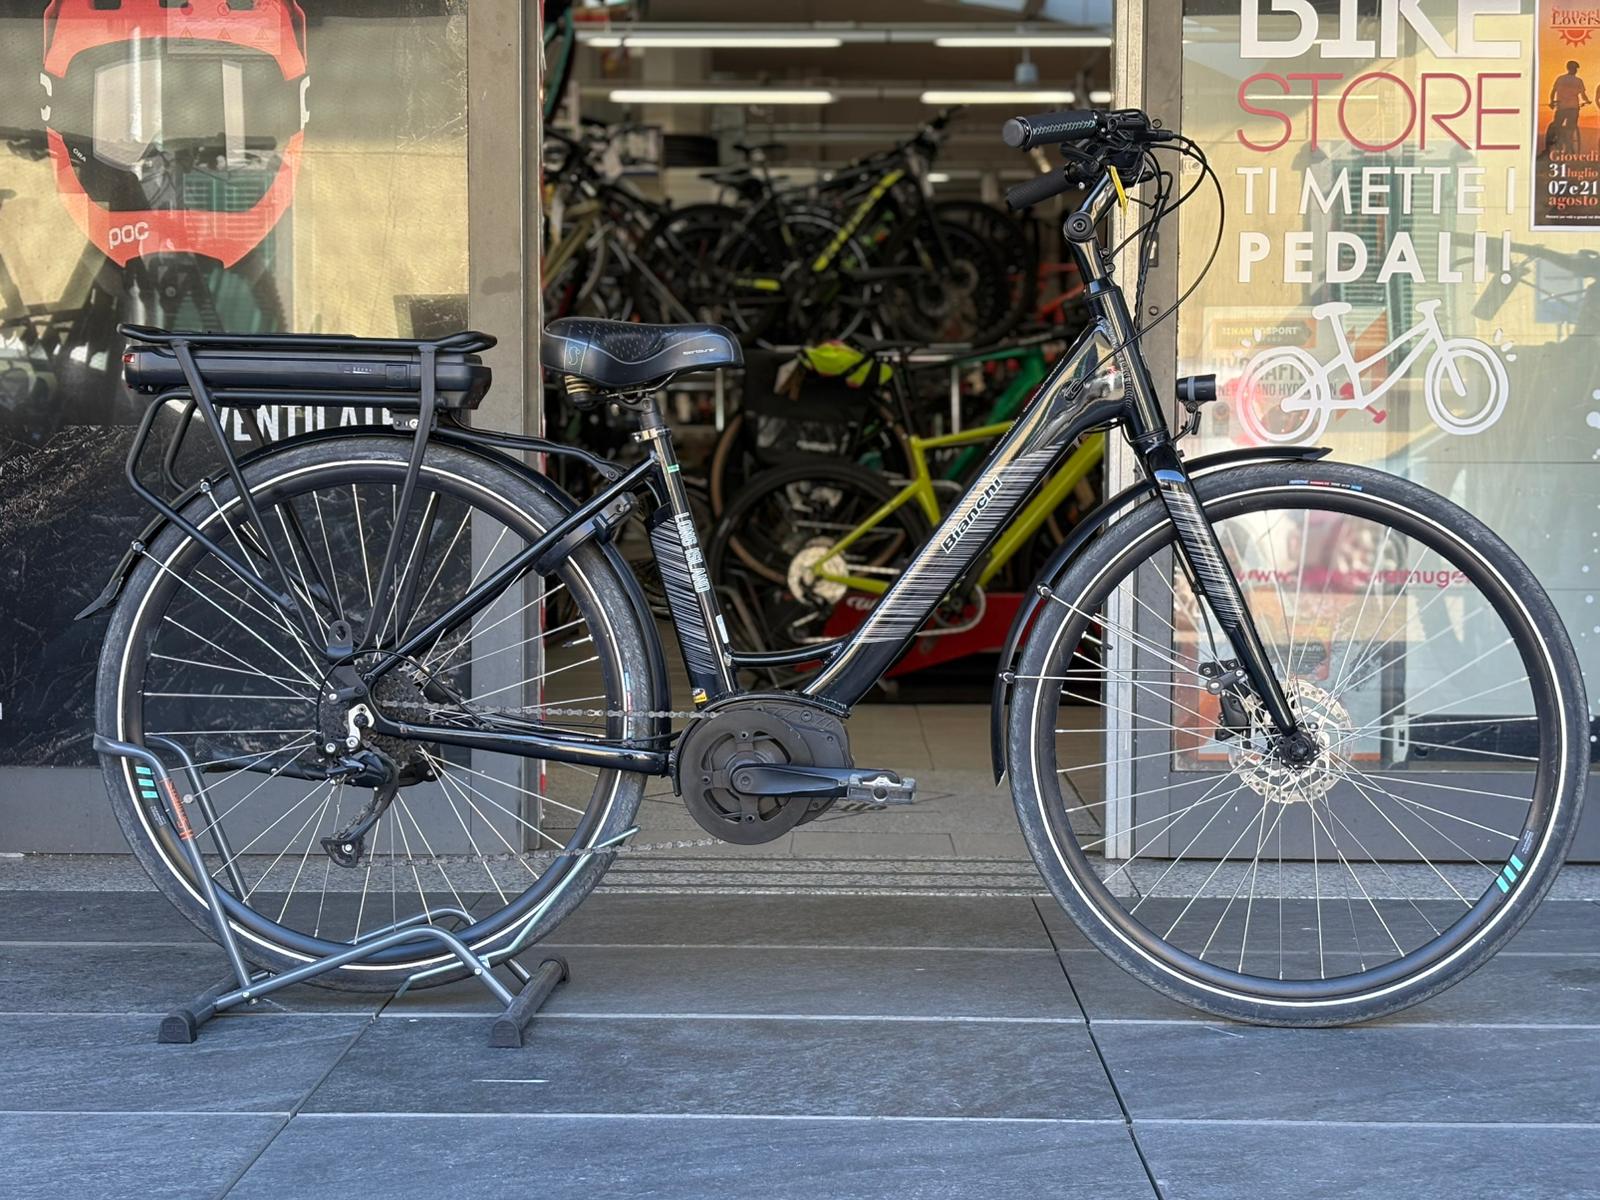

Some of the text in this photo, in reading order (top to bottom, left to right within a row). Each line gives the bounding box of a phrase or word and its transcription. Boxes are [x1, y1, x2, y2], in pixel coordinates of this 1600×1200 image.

[1240, 0, 1521, 58] BIKE
[1236, 71, 1521, 152] STORE
[1236, 167, 1516, 214] TI METTE I
[1548, 180, 1567, 195] 07
[1580, 180, 1598, 195] 21
[1549, 163, 1599, 181] 31 luglio
[1548, 195, 1598, 209] agosto
[1238, 231, 1512, 285] PEDALI!
[940, 475, 1003, 554] Bianchi
[674, 511, 711, 593] LONG ISLAND
